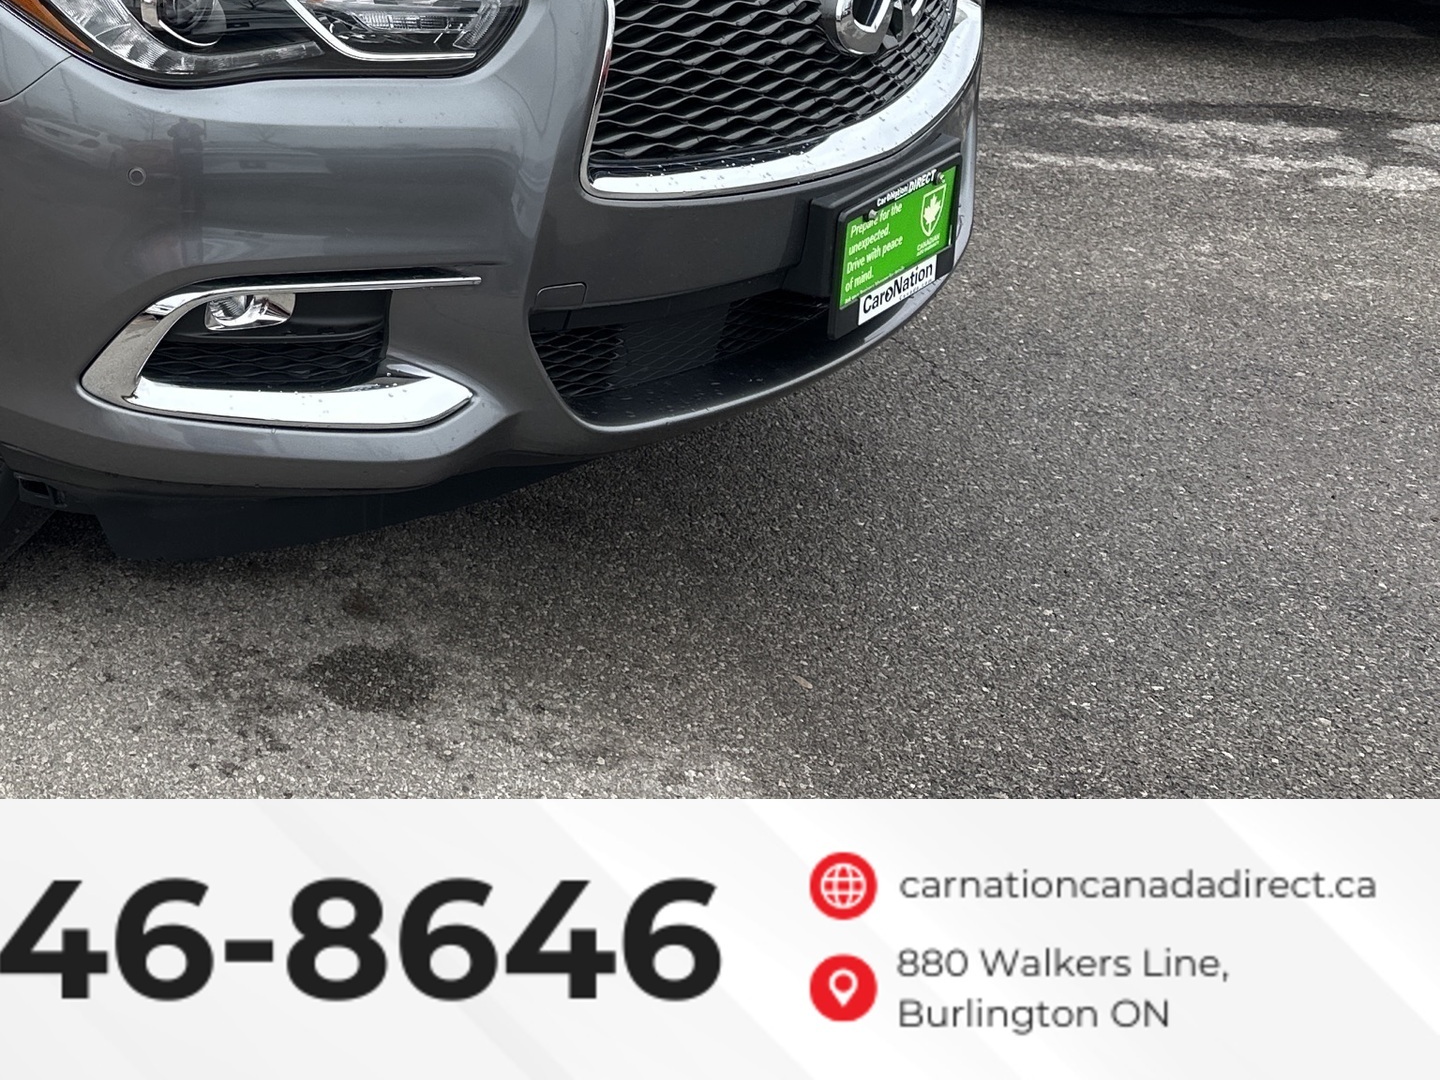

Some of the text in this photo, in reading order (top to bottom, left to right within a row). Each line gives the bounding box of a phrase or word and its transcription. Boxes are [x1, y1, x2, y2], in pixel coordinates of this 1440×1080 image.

[908, 169, 937, 193] DIRECT
[850, 202, 903, 238] Prepare for the
[846, 256, 865, 274] Drive
[866, 246, 881, 265] with
[881, 236, 903, 258] peace
[848, 223, 891, 255] unexpected.
[845, 277, 854, 293] of
[854, 266, 874, 288] mind.
